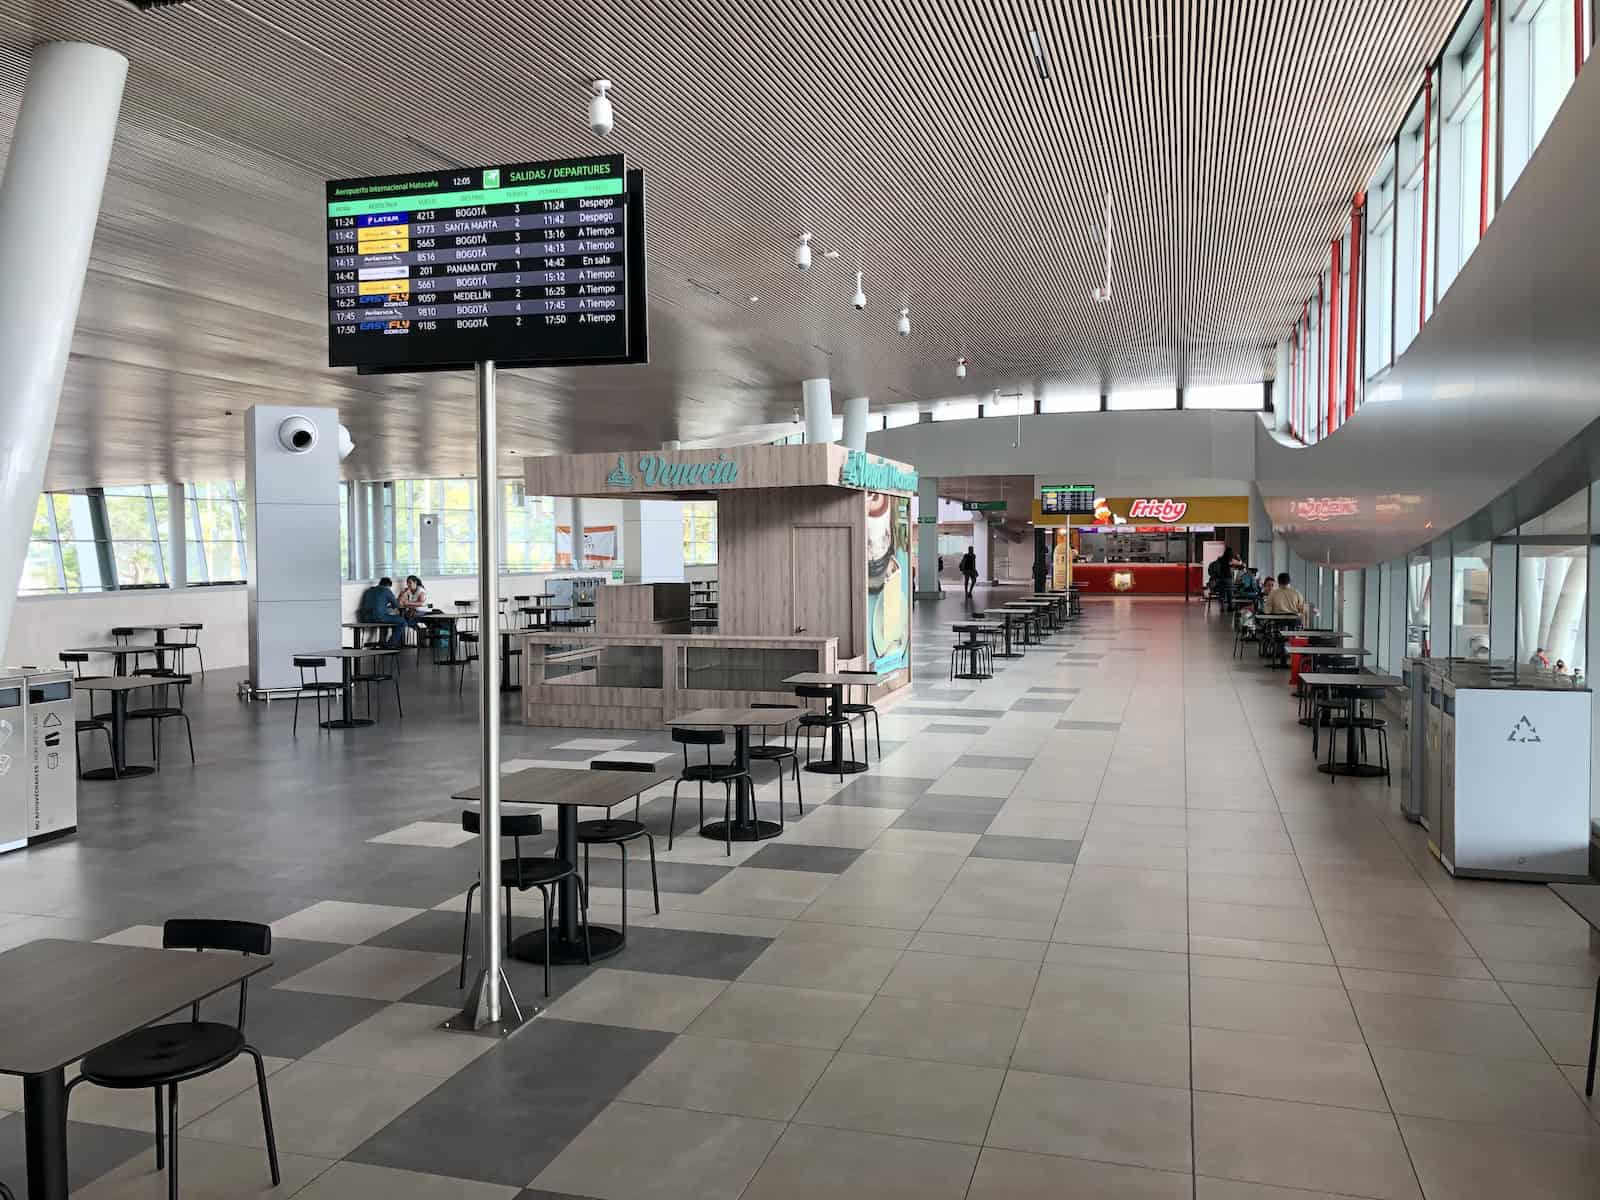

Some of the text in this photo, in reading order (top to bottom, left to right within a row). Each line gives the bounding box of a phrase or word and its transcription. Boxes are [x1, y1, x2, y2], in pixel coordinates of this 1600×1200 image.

[510, 168, 546, 182] SALIDAS
[553, 163, 611, 178] DEPARTURES
[417, 211, 435, 220] 4213
[456, 207, 486, 217] BOGOTÁ
[515, 204, 520, 213] 3
[544, 201, 565, 210] 11:24
[417, 225, 435, 234] 5773
[445, 223, 469, 232] SANTA
[471, 220, 497, 230] MARTA
[515, 219, 520, 227] 2
[544, 215, 565, 224] 11:42
[456, 235, 487, 245] BOGOTÁ
[515, 232, 520, 241] 3
[544, 230, 565, 239] 13:16
[578, 228, 584, 237] A
[586, 226, 614, 236] Tiempo
[456, 249, 487, 259] BOGOTÁ
[515, 247, 520, 255] 4
[544, 244, 565, 253] 14:13
[578, 242, 584, 250] A
[586, 241, 614, 251] Tiempo
[420, 267, 432, 275] 201
[447, 264, 480, 273] PANAMA
[481, 262, 497, 271] CITY
[516, 261, 520, 269] 1
[583, 257, 592, 265] En
[418, 280, 435, 289] 5661
[456, 277, 487, 287] BOGOTÁ
[515, 275, 521, 283] 2
[545, 272, 565, 281] 15:12
[579, 271, 585, 280] A
[587, 270, 615, 280] Tiempo
[418, 294, 436, 303] 9059
[454, 289, 491, 301] MEDELLÍN
[516, 289, 521, 298] 2
[545, 287, 566, 296] 16:25
[579, 285, 585, 294] A
[587, 284, 615, 294] Tiempo
[457, 304, 488, 314] BOGOTÁ
[516, 303, 521, 311] 4
[545, 301, 566, 310] 17:45
[579, 300, 585, 308] A
[587, 298, 615, 308] Tiempo
[337, 325, 355, 334] 17:50
[457, 318, 488, 329] BOGOTÁ
[516, 317, 522, 326] 2
[545, 315, 566, 324] 17:50
[579, 314, 585, 322] A
[587, 313, 616, 323] Tiempo
[639, 452, 738, 487] Venecia
[1129, 498, 1188, 523] Frisby
